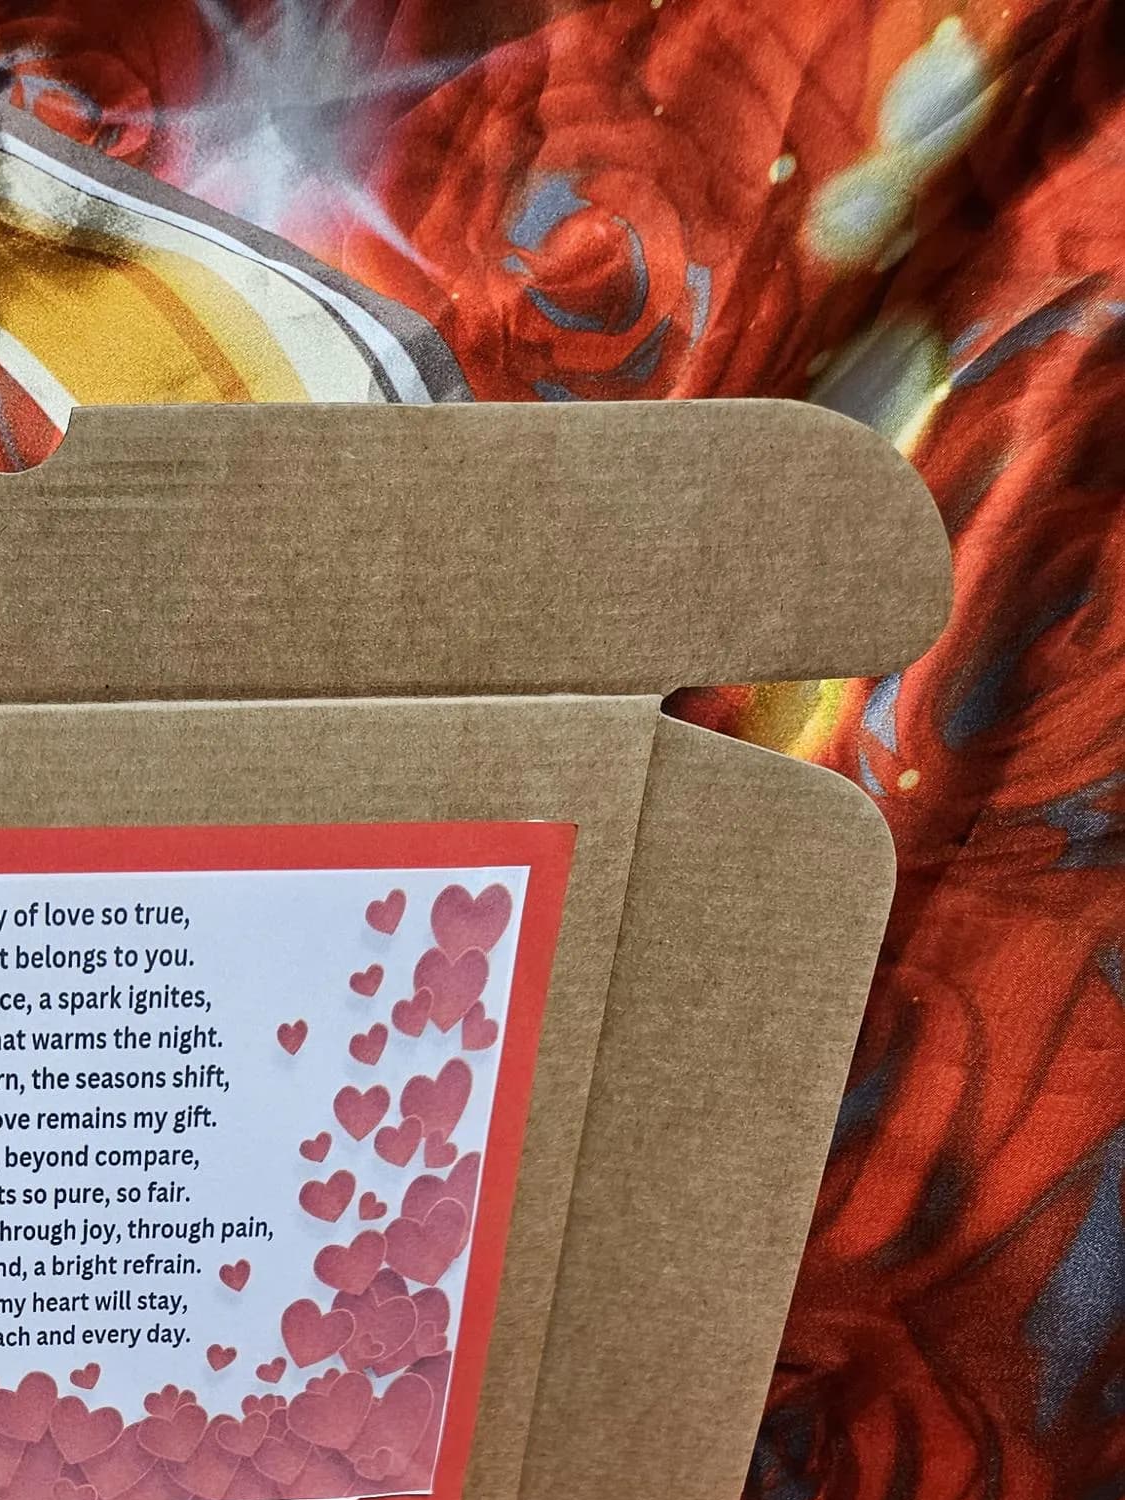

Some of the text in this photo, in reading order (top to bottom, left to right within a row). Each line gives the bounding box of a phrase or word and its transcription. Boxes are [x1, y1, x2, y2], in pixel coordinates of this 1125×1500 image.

[13, 901, 39, 927] of
[45, 901, 95, 927] love
[101, 907, 128, 926] so
[134, 902, 190, 930] true,
[15, 944, 108, 975] belongs
[113, 945, 138, 968] to
[143, 948, 194, 974] you.
[39, 992, 53, 1010] a
[58, 984, 122, 1016] spark
[128, 984, 212, 1015] ignites,
[31, 1032, 107, 1051] warms
[113, 1025, 152, 1050] the
[158, 1024, 223, 1055] night.
[31, 1066, 70, 1090] the
[75, 1071, 166, 1090] seasons
[172, 1064, 230, 1093] shift,
[37, 1106, 127, 1130] remains
[133, 1111, 169, 1134] my
[172, 1104, 217, 1134] gift.
[5, 1144, 89, 1174] beyond
[95, 1148, 200, 1172] compare,
[22, 1187, 47, 1205] so
[54, 1187, 110, 1210] pure,
[116, 1186, 141, 1203] so
[147, 1180, 191, 1203] fair.
[80, 1218, 122, 1246] joy,
[127, 1217, 215, 1244] through
[220, 1215, 274, 1244] pain,
[33, 1260, 47, 1277] a
[52, 1254, 118, 1281] bright
[123, 1253, 202, 1275] refrain.
[32, 1291, 90, 1313] heart
[94, 1289, 132, 1311] will
[137, 1291, 188, 1316] stay,
[36, 1324, 76, 1346] and
[81, 1328, 142, 1349] every
[146, 1322, 191, 1349] day.
